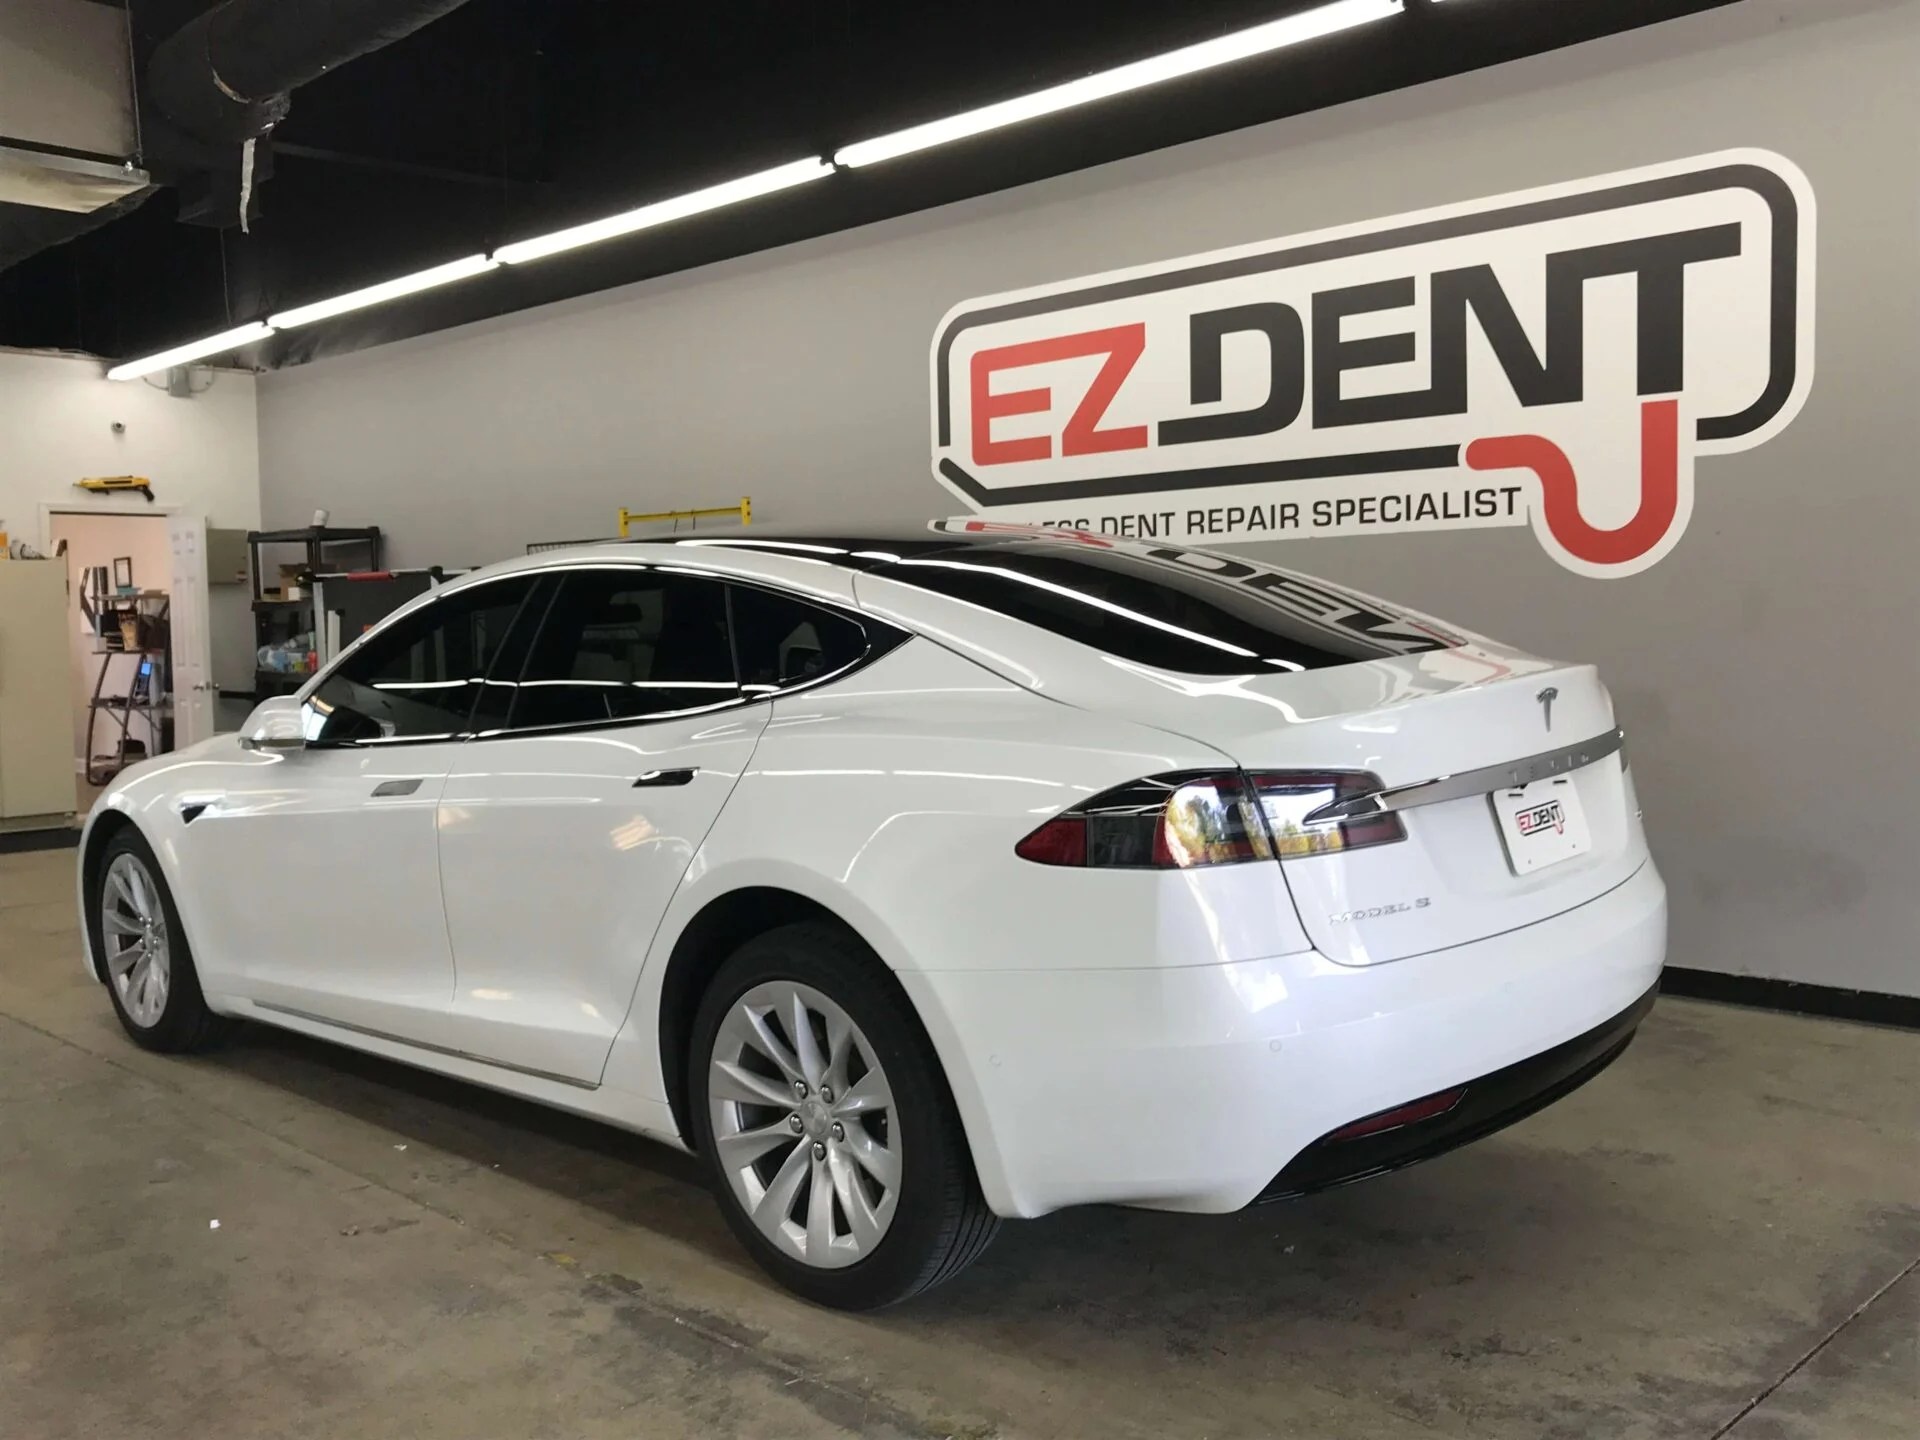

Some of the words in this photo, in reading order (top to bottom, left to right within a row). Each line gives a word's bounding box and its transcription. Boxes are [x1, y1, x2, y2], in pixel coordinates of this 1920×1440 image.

[970, 322, 1148, 466] EZ
[1157, 221, 1742, 446] DENT
[1100, 511, 1176, 539] DENT
[1186, 503, 1301, 535] REPAIR
[1312, 486, 1523, 527] SPECIALIST
[1532, 804, 1561, 827] DENT
